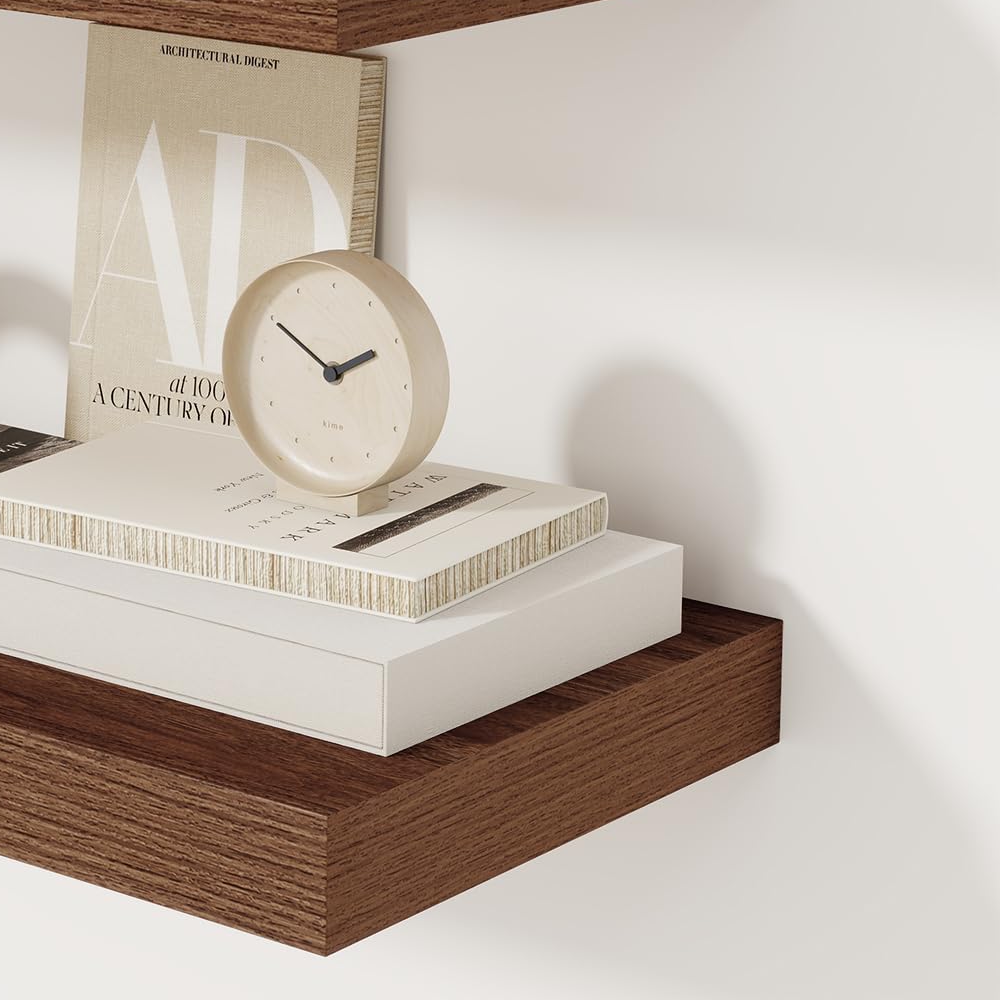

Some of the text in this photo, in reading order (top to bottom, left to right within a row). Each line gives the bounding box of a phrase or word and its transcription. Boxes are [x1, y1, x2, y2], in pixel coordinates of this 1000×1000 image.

[159, 44, 280, 70] ARCHITECTURAL DIGEST
[92, 382, 106, 405] A
[110, 386, 206, 421] CENTURY
[169, 375, 226, 402] at 100
